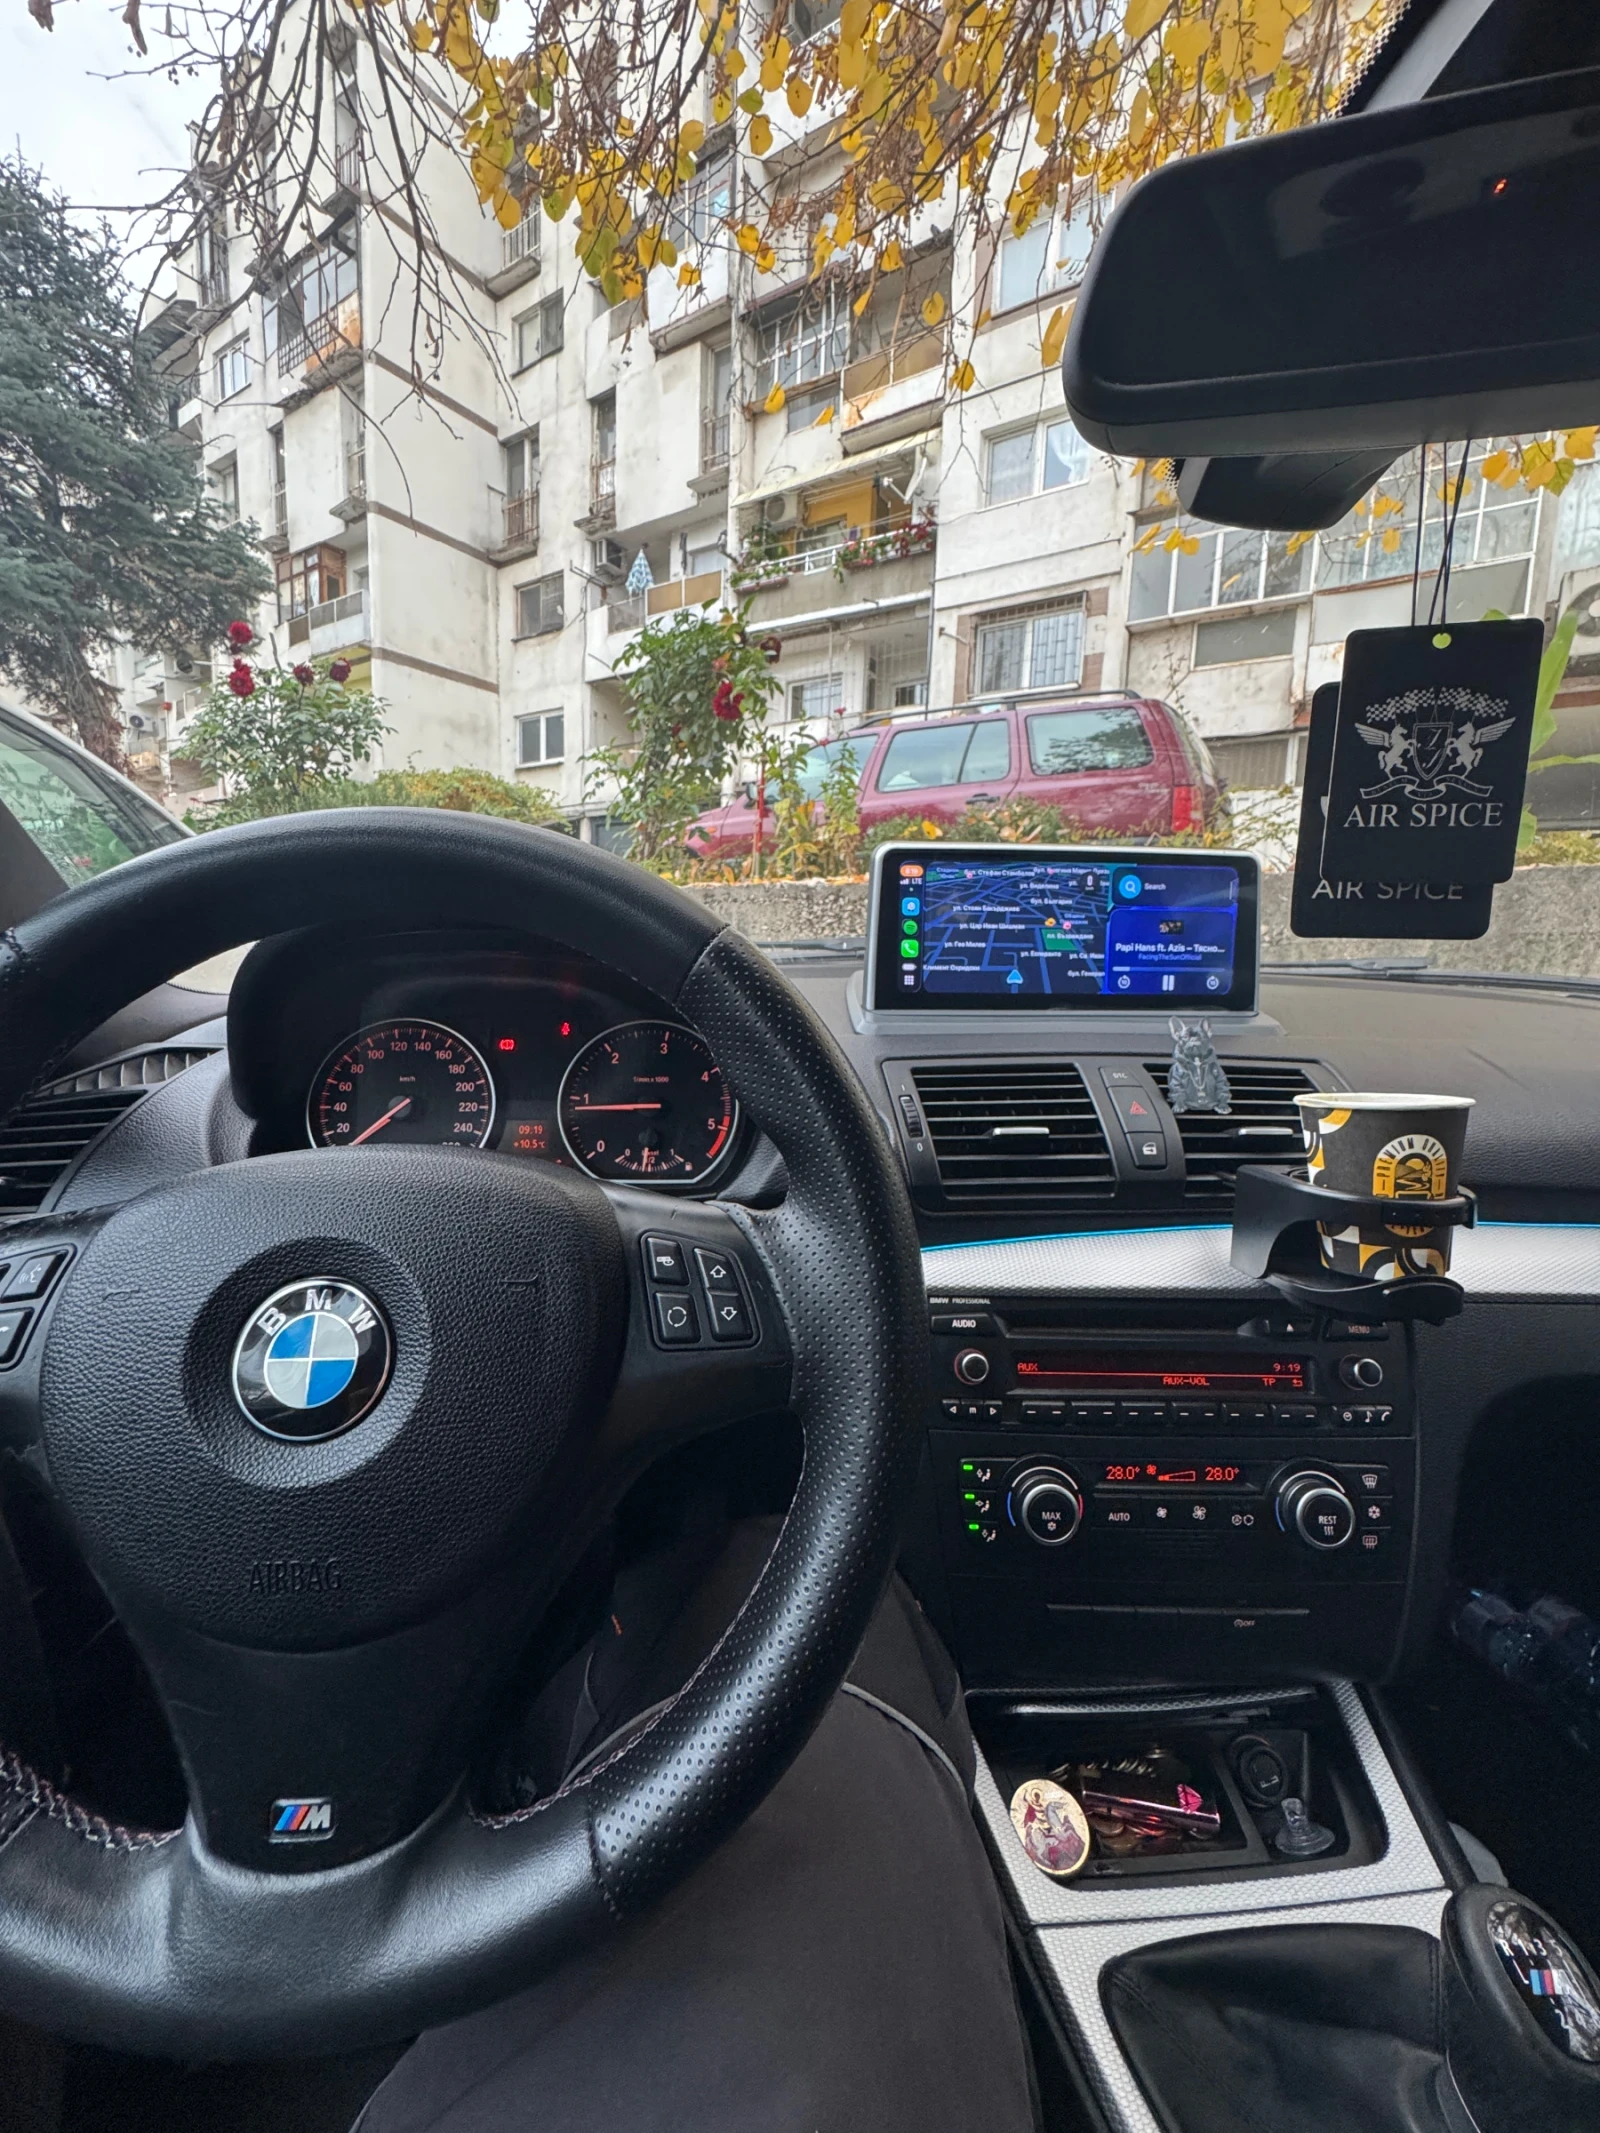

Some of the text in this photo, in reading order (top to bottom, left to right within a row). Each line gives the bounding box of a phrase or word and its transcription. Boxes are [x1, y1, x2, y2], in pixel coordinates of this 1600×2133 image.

[1343, 802, 1503, 828] AIR SPICE
[1144, 882, 1166, 891] Search
[1311, 880, 1463, 899] AIR SPICE
[1115, 943, 1134, 953] Papi
[1135, 943, 1156, 953] Hans
[1157, 943, 1166, 953] ft.
[1167, 943, 1186, 953] Azis
[390, 1041, 408, 1051] 120
[414, 1041, 431, 1051] 140
[660, 1043, 668, 1054] 3
[367, 1050, 385, 1060] 100
[435, 1050, 452, 1060] 160
[611, 1053, 619, 1064] 2
[350, 1064, 364, 1074] 80
[448, 1064, 465, 1074] 180
[701, 1071, 709, 1082] 4
[339, 1082, 352, 1092] 60
[455, 1082, 475, 1092] 200
[583, 1093, 589, 1104] 1
[333, 1102, 347, 1112] 40
[458, 1102, 478, 1112] 220
[337, 1123, 350, 1133] 20
[453, 1123, 473, 1133] 240
[707, 1118, 715, 1130] 5
[518, 1124, 543, 1135] 09:19
[596, 1140, 605, 1152] 0
[624, 1148, 630, 1156] 0
[1376, 1137, 1414, 1178] PREMIUM
[952, 1297, 991, 1305] PROFESSIONAL
[257, 1289, 377, 1337] BMW
[951, 1319, 977, 1328] AUDIO
[1348, 1325, 1370, 1334] MENU
[1017, 1362, 1038, 1371] AUX
[1273, 1362, 1301, 1372] 9:19
[1163, 1376, 1276, 1386] AUX-VOL TP
[1041, 1511, 1061, 1520] MAX
[1108, 1512, 1131, 1522] AUTO
[1318, 1515, 1337, 1525] REST
[249, 1558, 340, 1593] AIRBAG
[297, 1804, 331, 1831] M
[1498, 1939, 1514, 1957] R
[1517, 1938, 1529, 1956] 1
[1533, 1937, 1547, 1956] 3
[1554, 2008, 1570, 2029] 2
